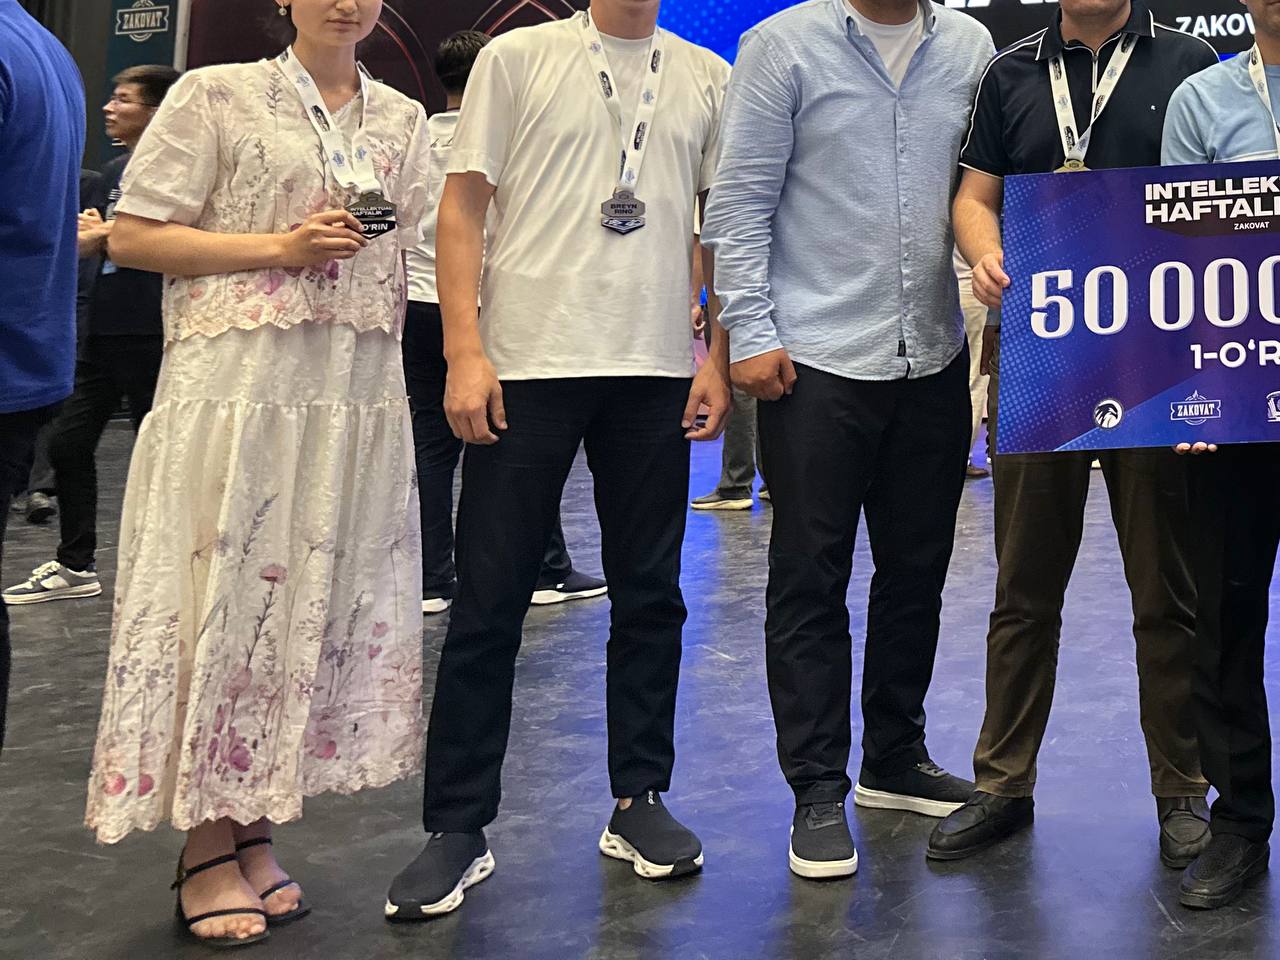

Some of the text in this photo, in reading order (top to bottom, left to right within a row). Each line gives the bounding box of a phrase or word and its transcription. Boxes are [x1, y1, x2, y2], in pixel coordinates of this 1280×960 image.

[122, 10, 162, 30] ZAKOVAT
[1233, 221, 1270, 230] ZAKOVAT
[1030, 265, 1129, 338] 50
[1177, 403, 1215, 417] ZAKOVAT
